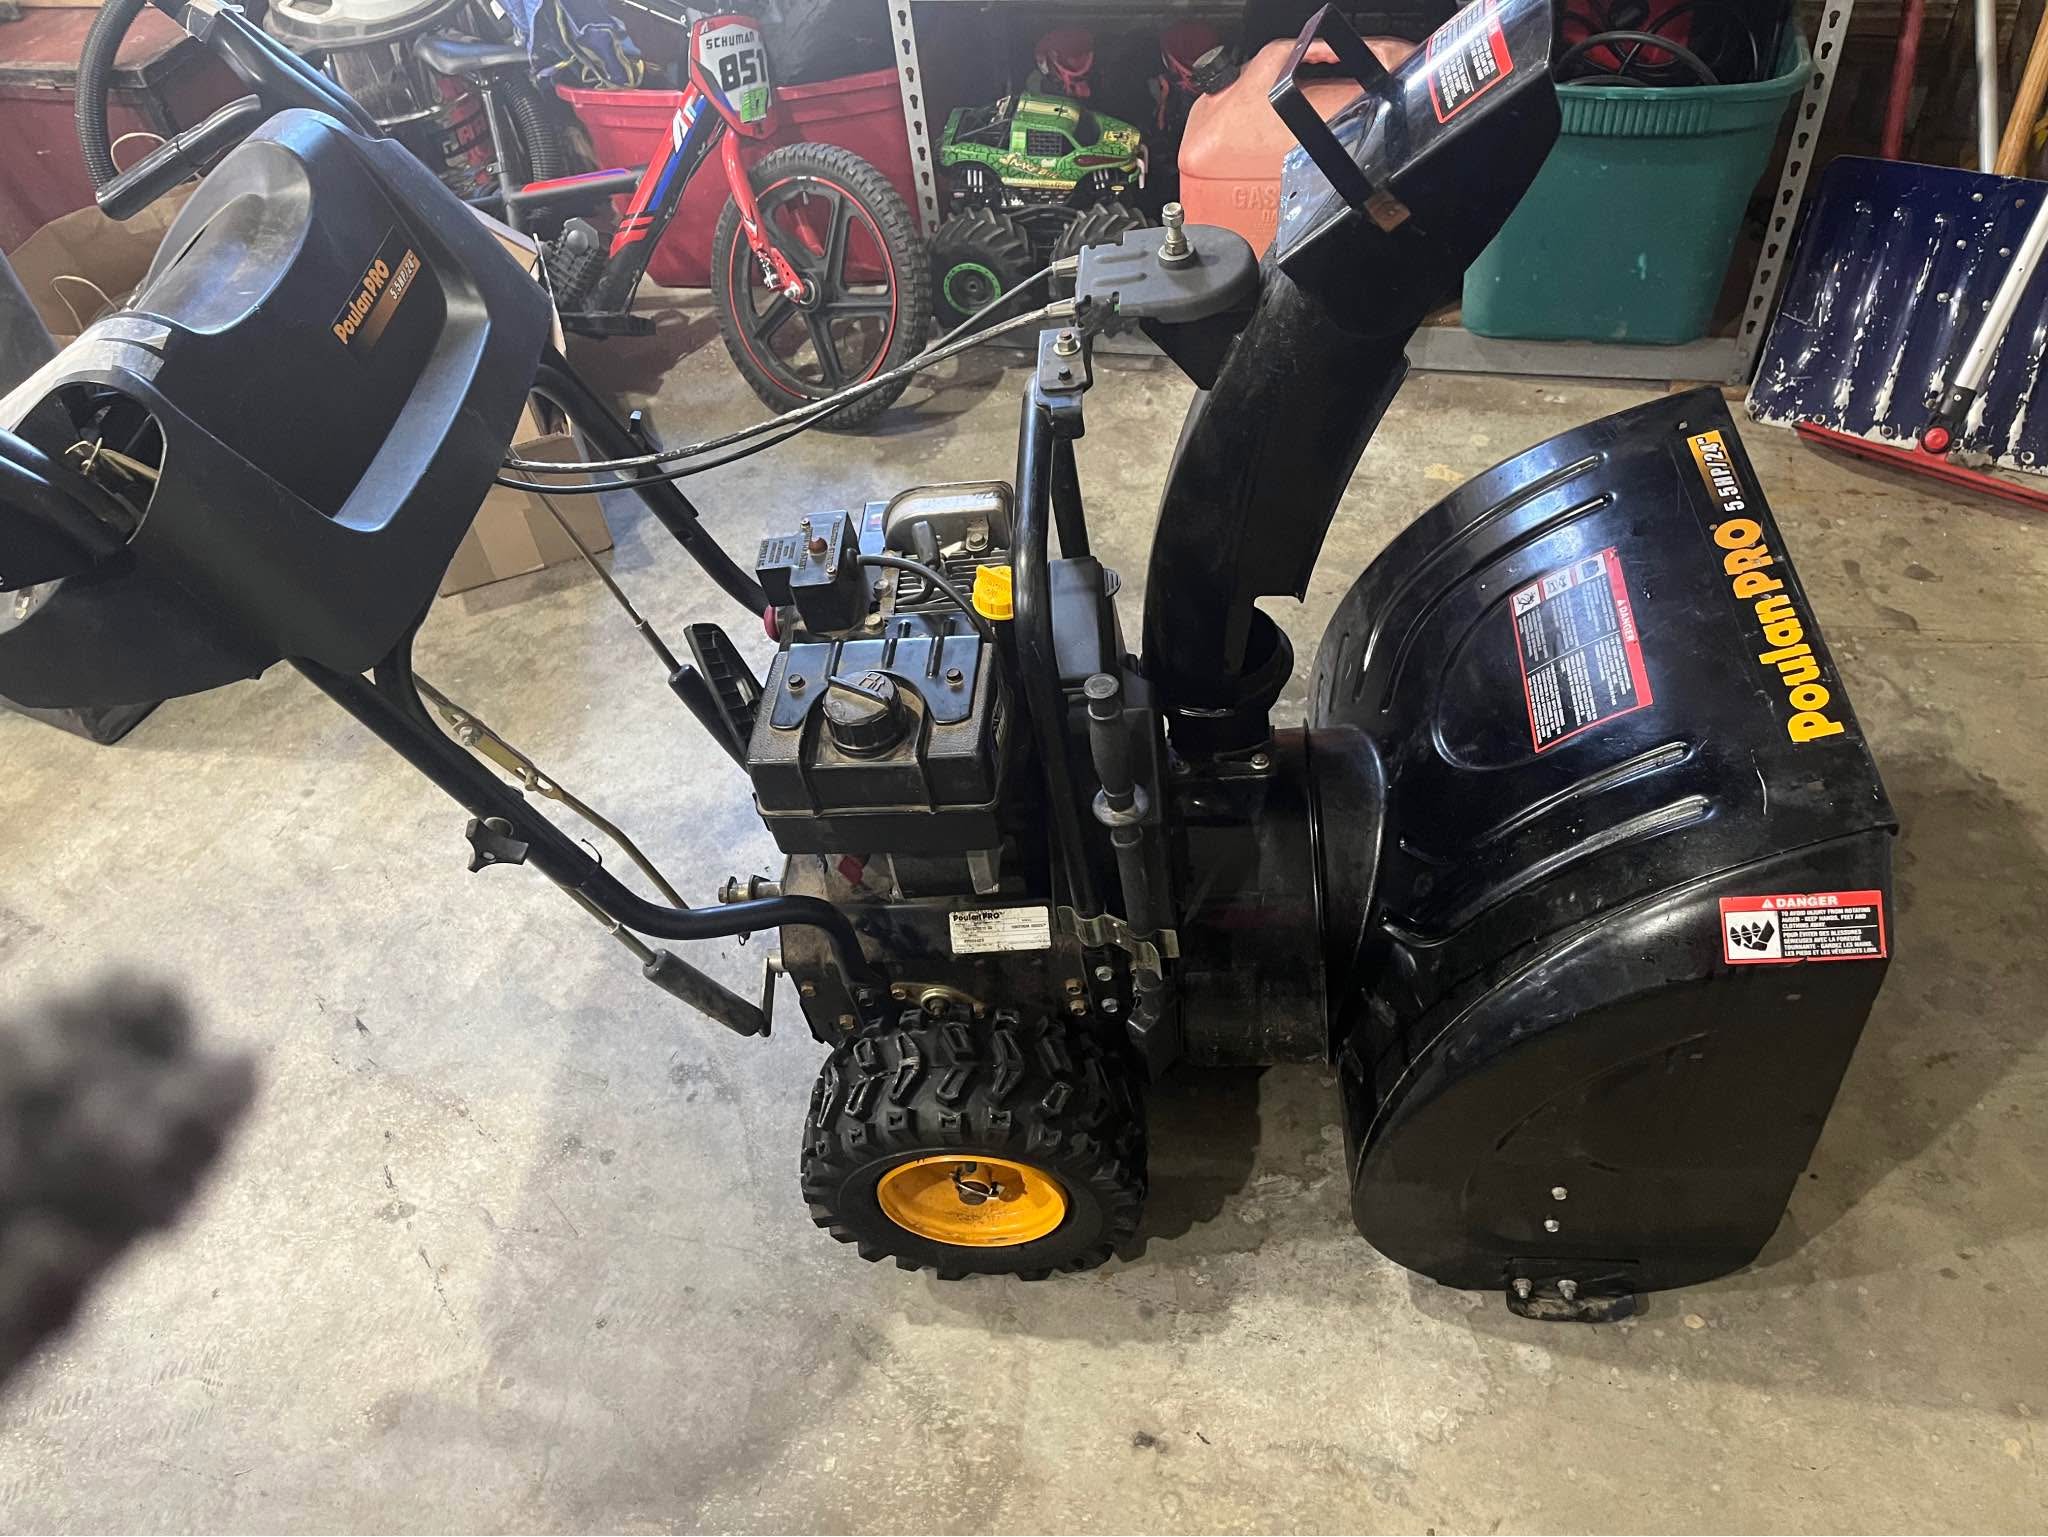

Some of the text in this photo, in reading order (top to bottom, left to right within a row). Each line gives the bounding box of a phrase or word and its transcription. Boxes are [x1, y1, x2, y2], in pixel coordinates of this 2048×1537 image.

[718, 48, 768, 92] 851
[1618, 603, 1634, 642] DANGER
[1776, 896, 1838, 908] DANGER
